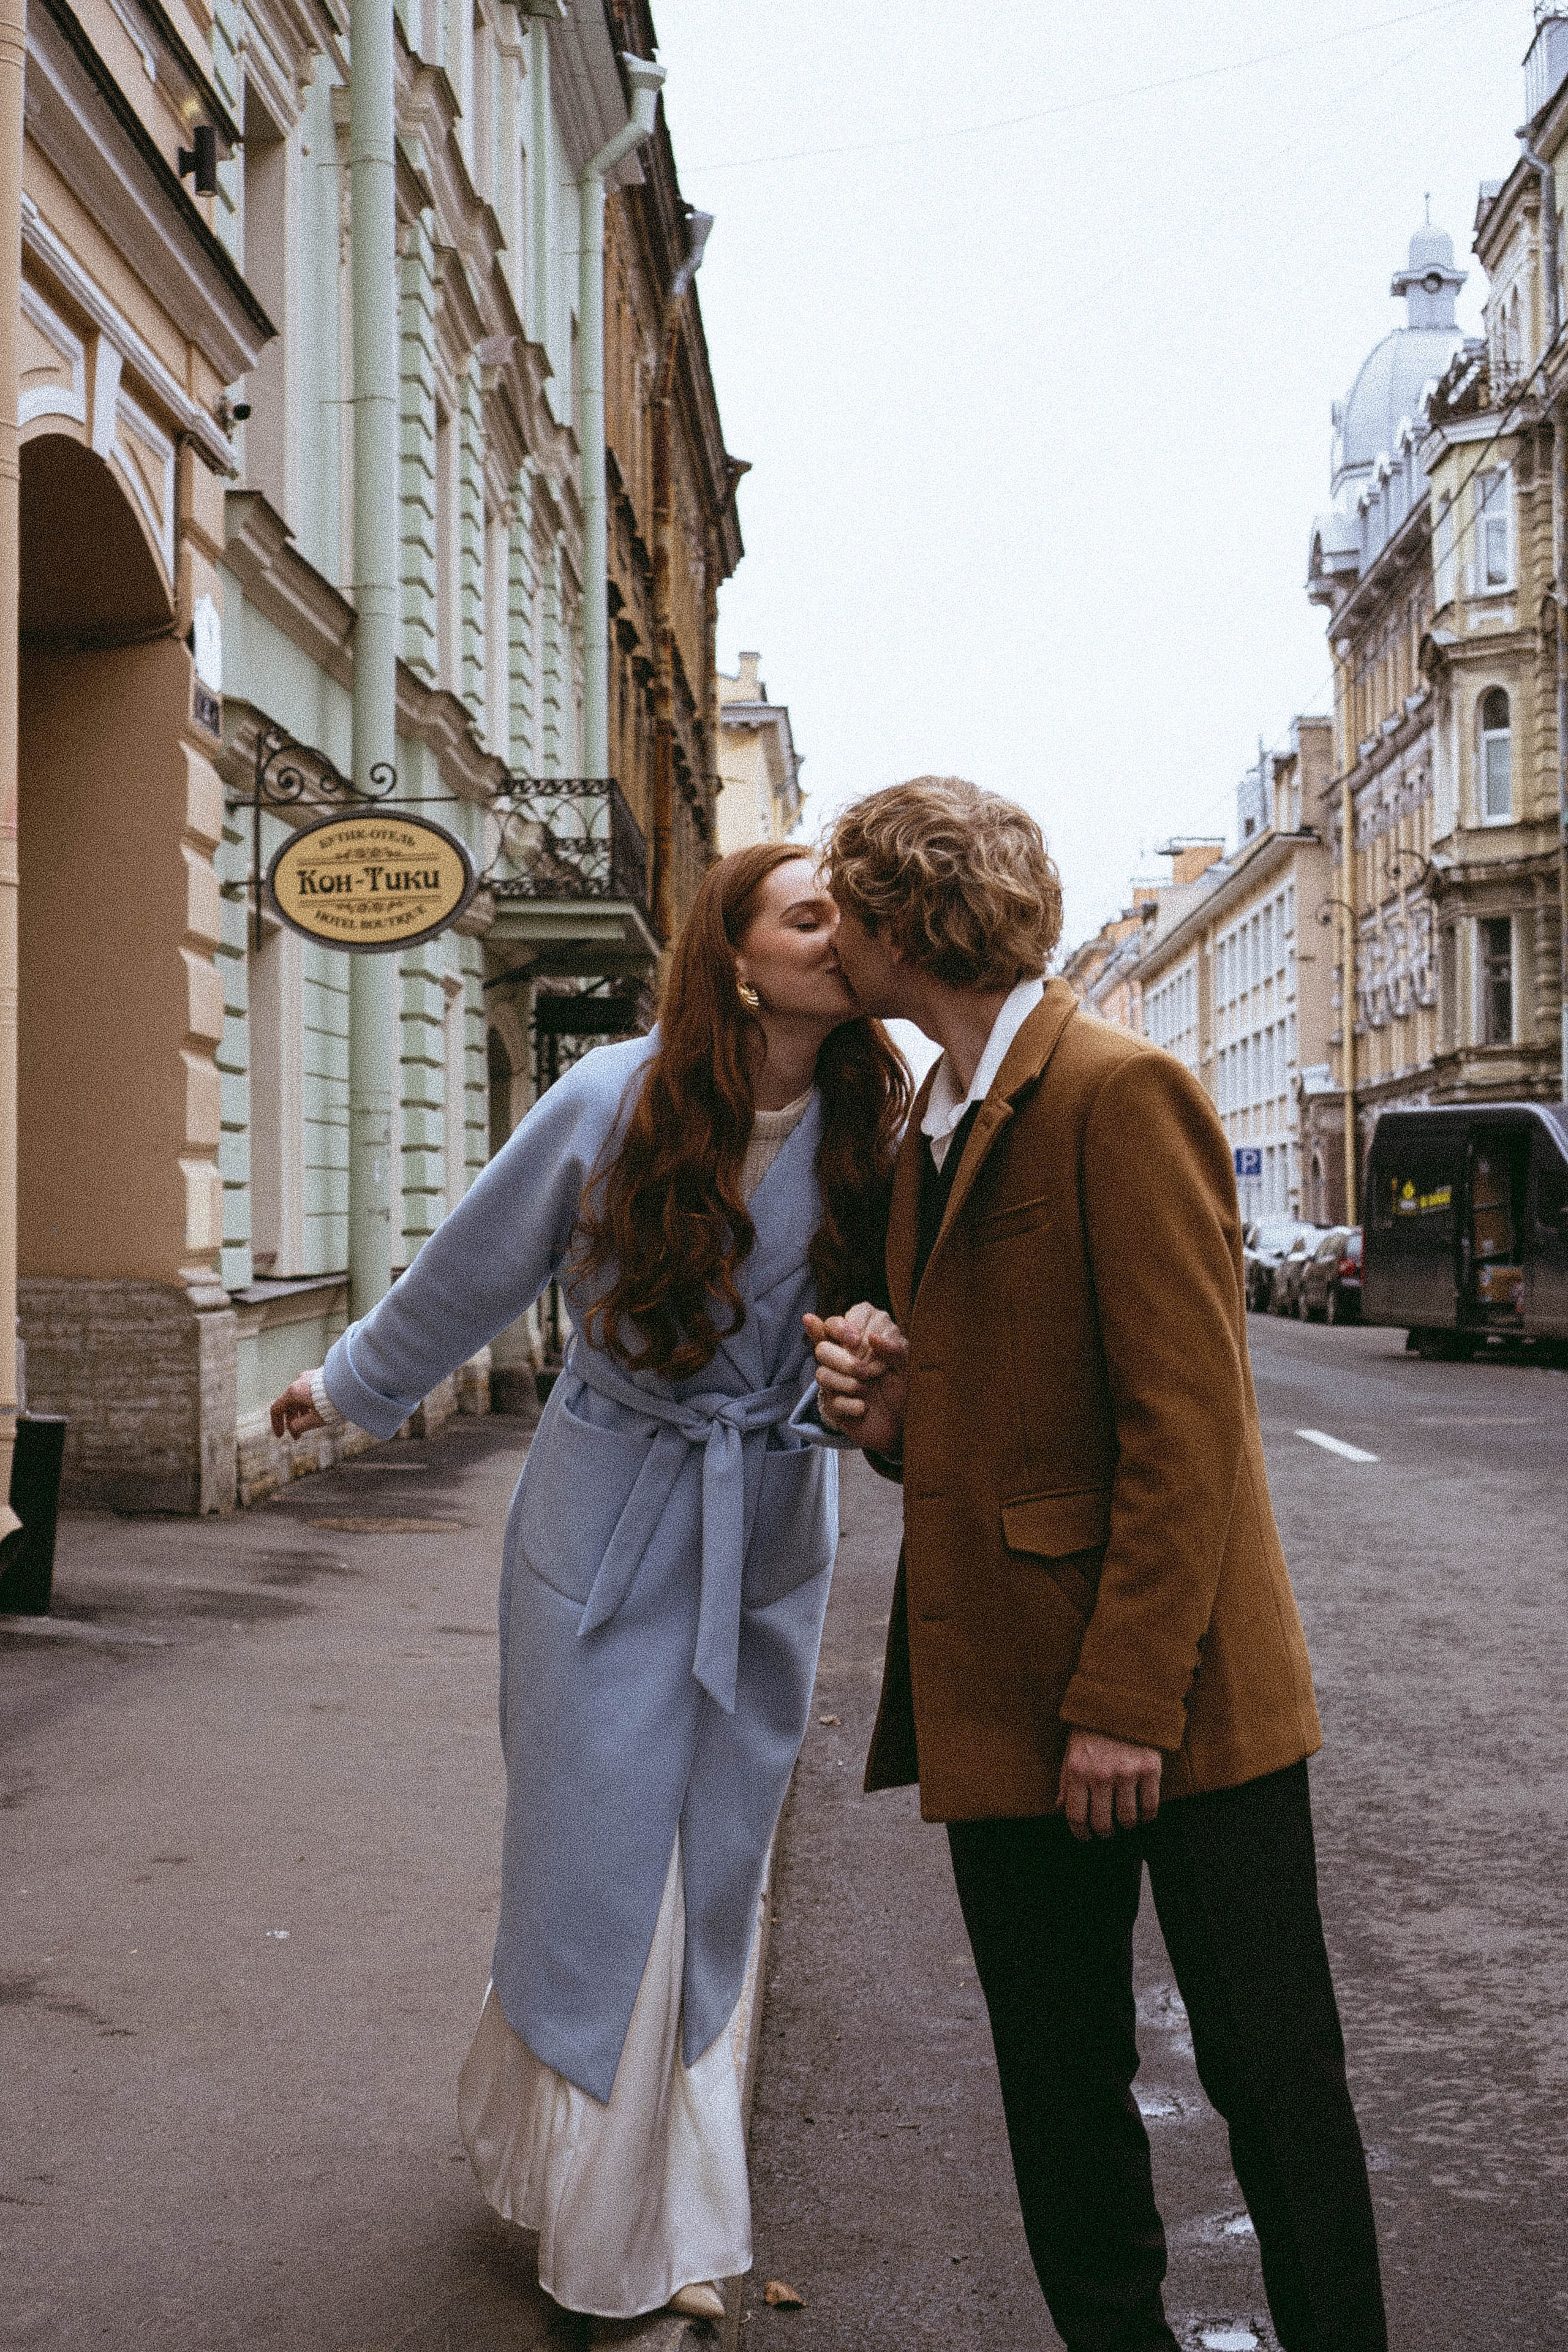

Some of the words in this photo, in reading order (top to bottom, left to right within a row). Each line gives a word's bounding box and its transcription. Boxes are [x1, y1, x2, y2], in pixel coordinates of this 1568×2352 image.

[296, 866, 439, 895] Кон-Тики
[315, 909, 355, 929] HOTEL
[1242, 1150, 1257, 1175] P
